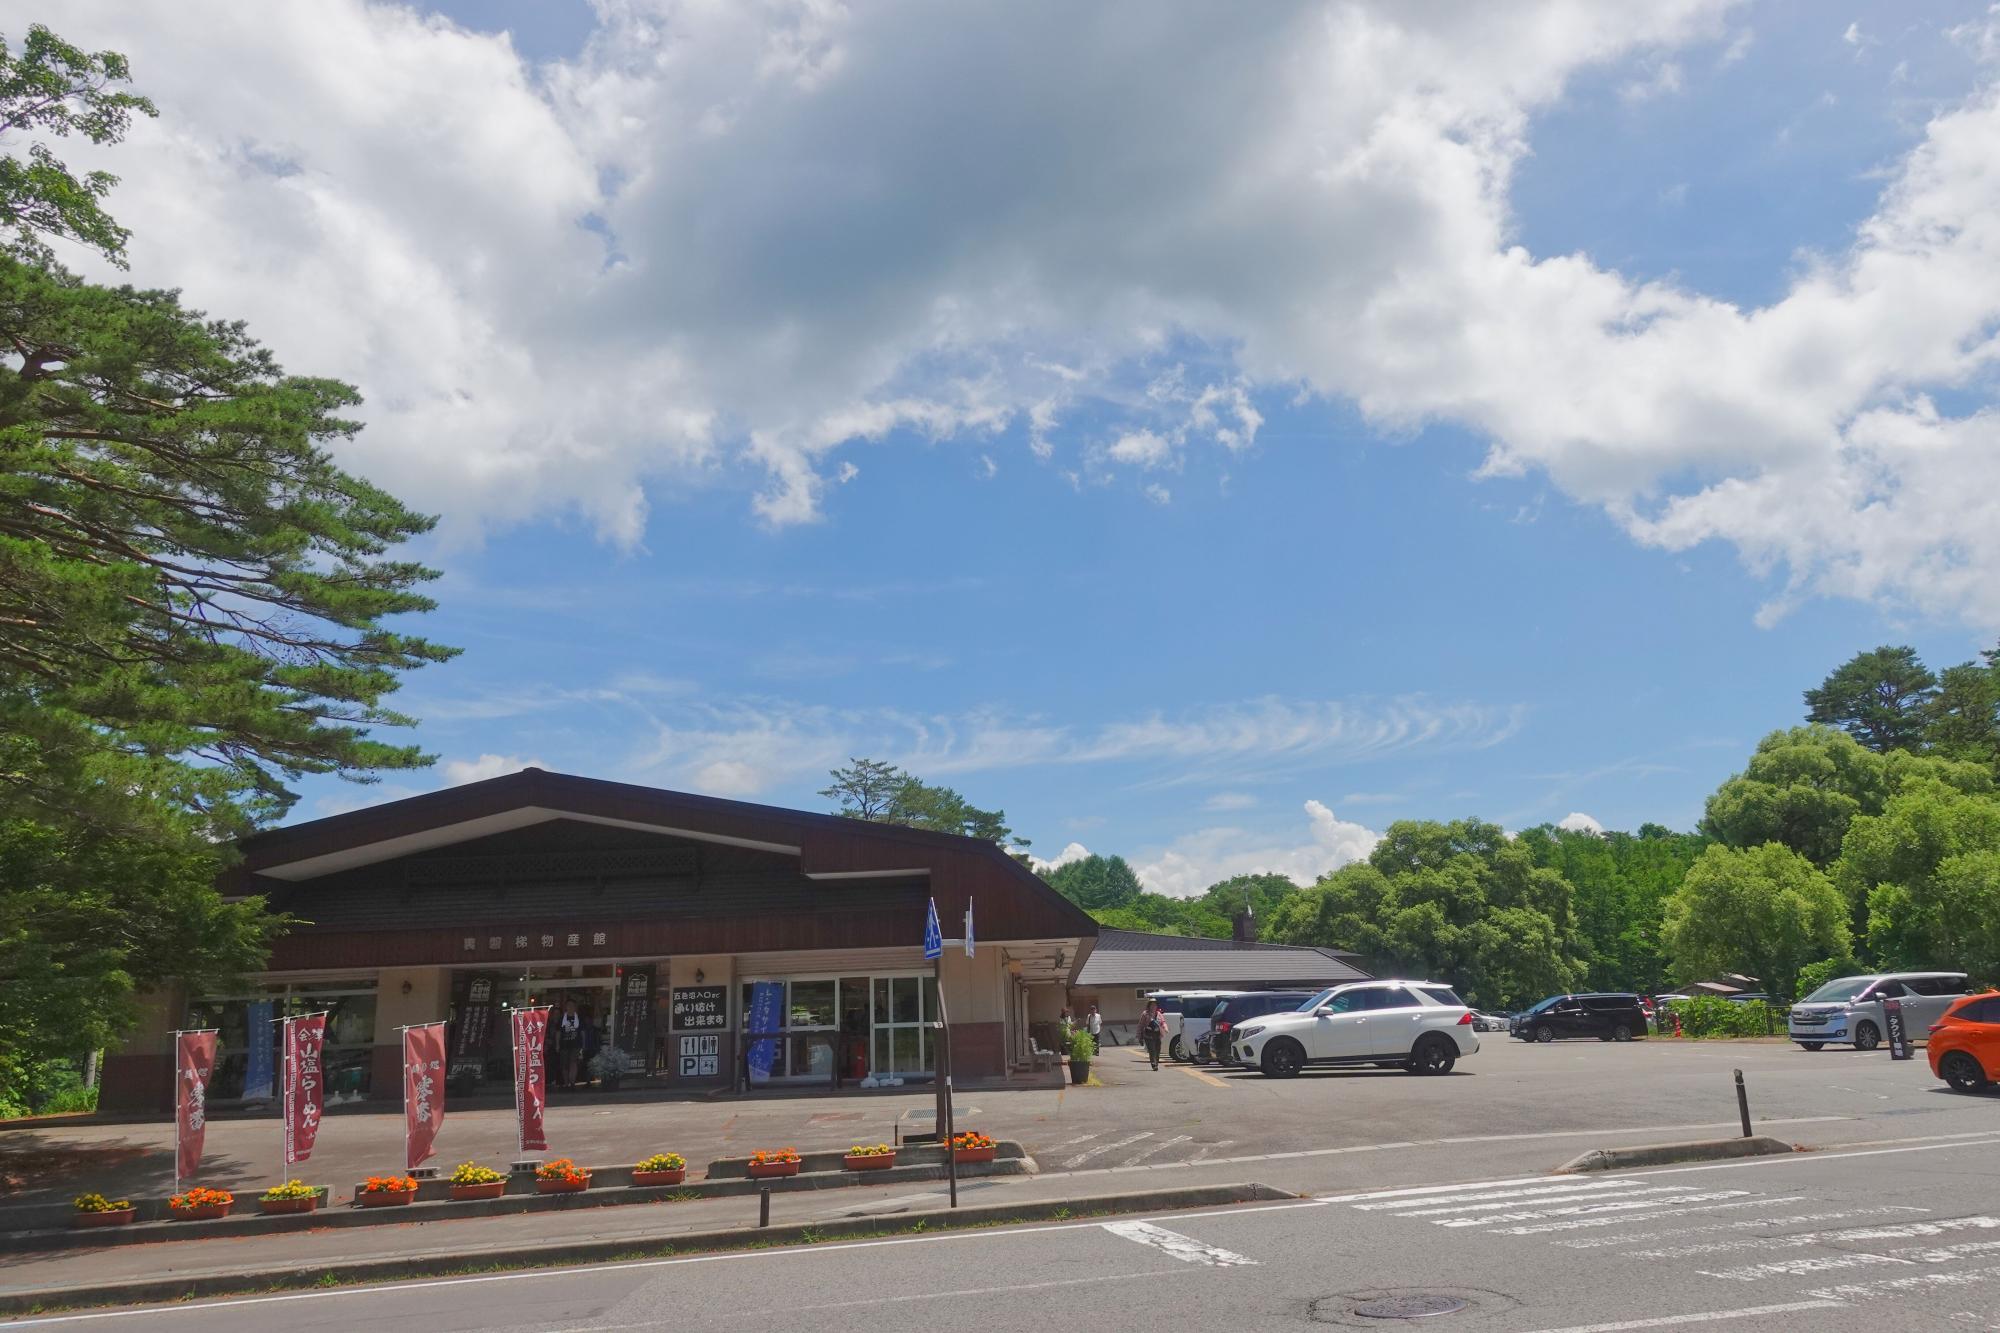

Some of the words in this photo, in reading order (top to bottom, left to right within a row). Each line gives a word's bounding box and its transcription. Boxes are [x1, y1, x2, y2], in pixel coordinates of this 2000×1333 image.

[674, 1002, 716, 1014] 通り抜け
[684, 1014, 724, 1027] 出来ます
[298, 1027, 325, 1042] 会津
[683, 1057, 697, 1075] P
[299, 1042, 320, 1129] 山塩らーめん
